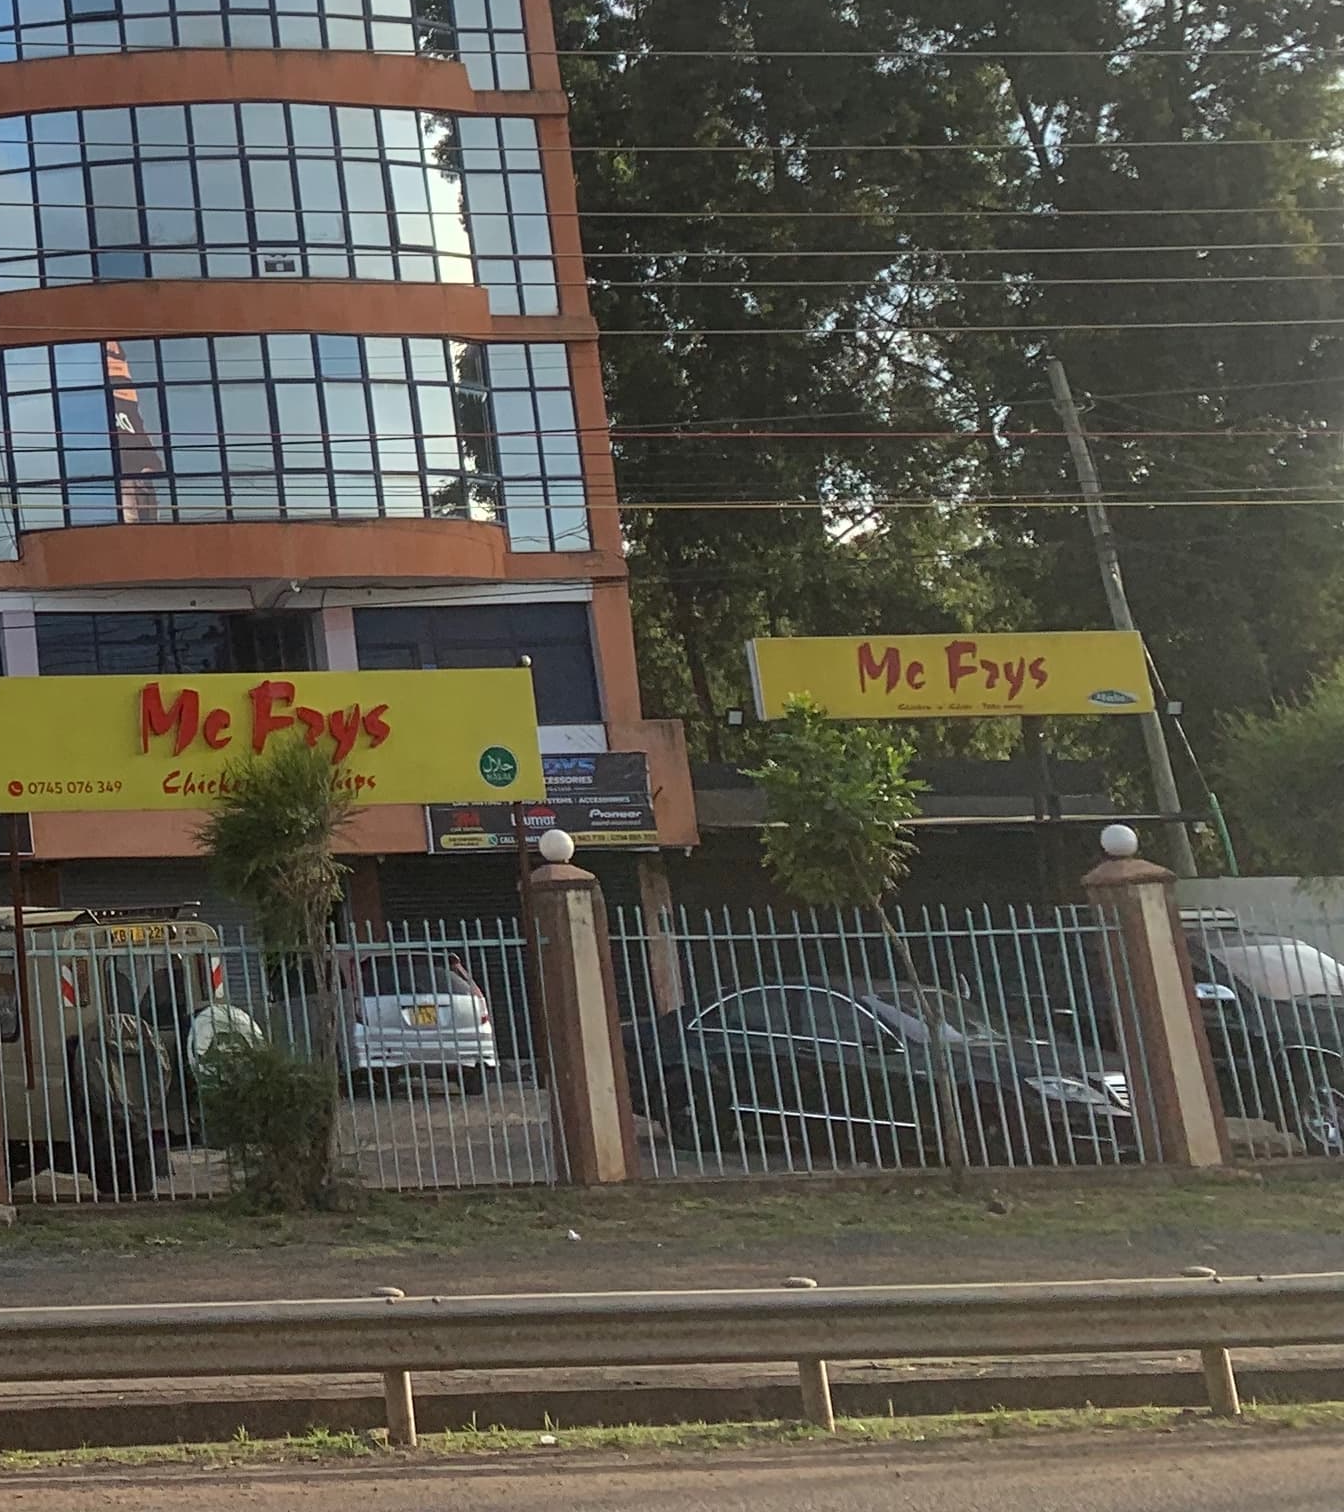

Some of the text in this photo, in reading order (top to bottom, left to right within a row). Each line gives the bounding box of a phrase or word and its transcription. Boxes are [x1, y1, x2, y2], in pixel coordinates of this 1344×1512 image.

[944, 639, 1049, 701] Frys
[251, 679, 392, 765] Frys
[28, 779, 123, 796] 0745 076 349
